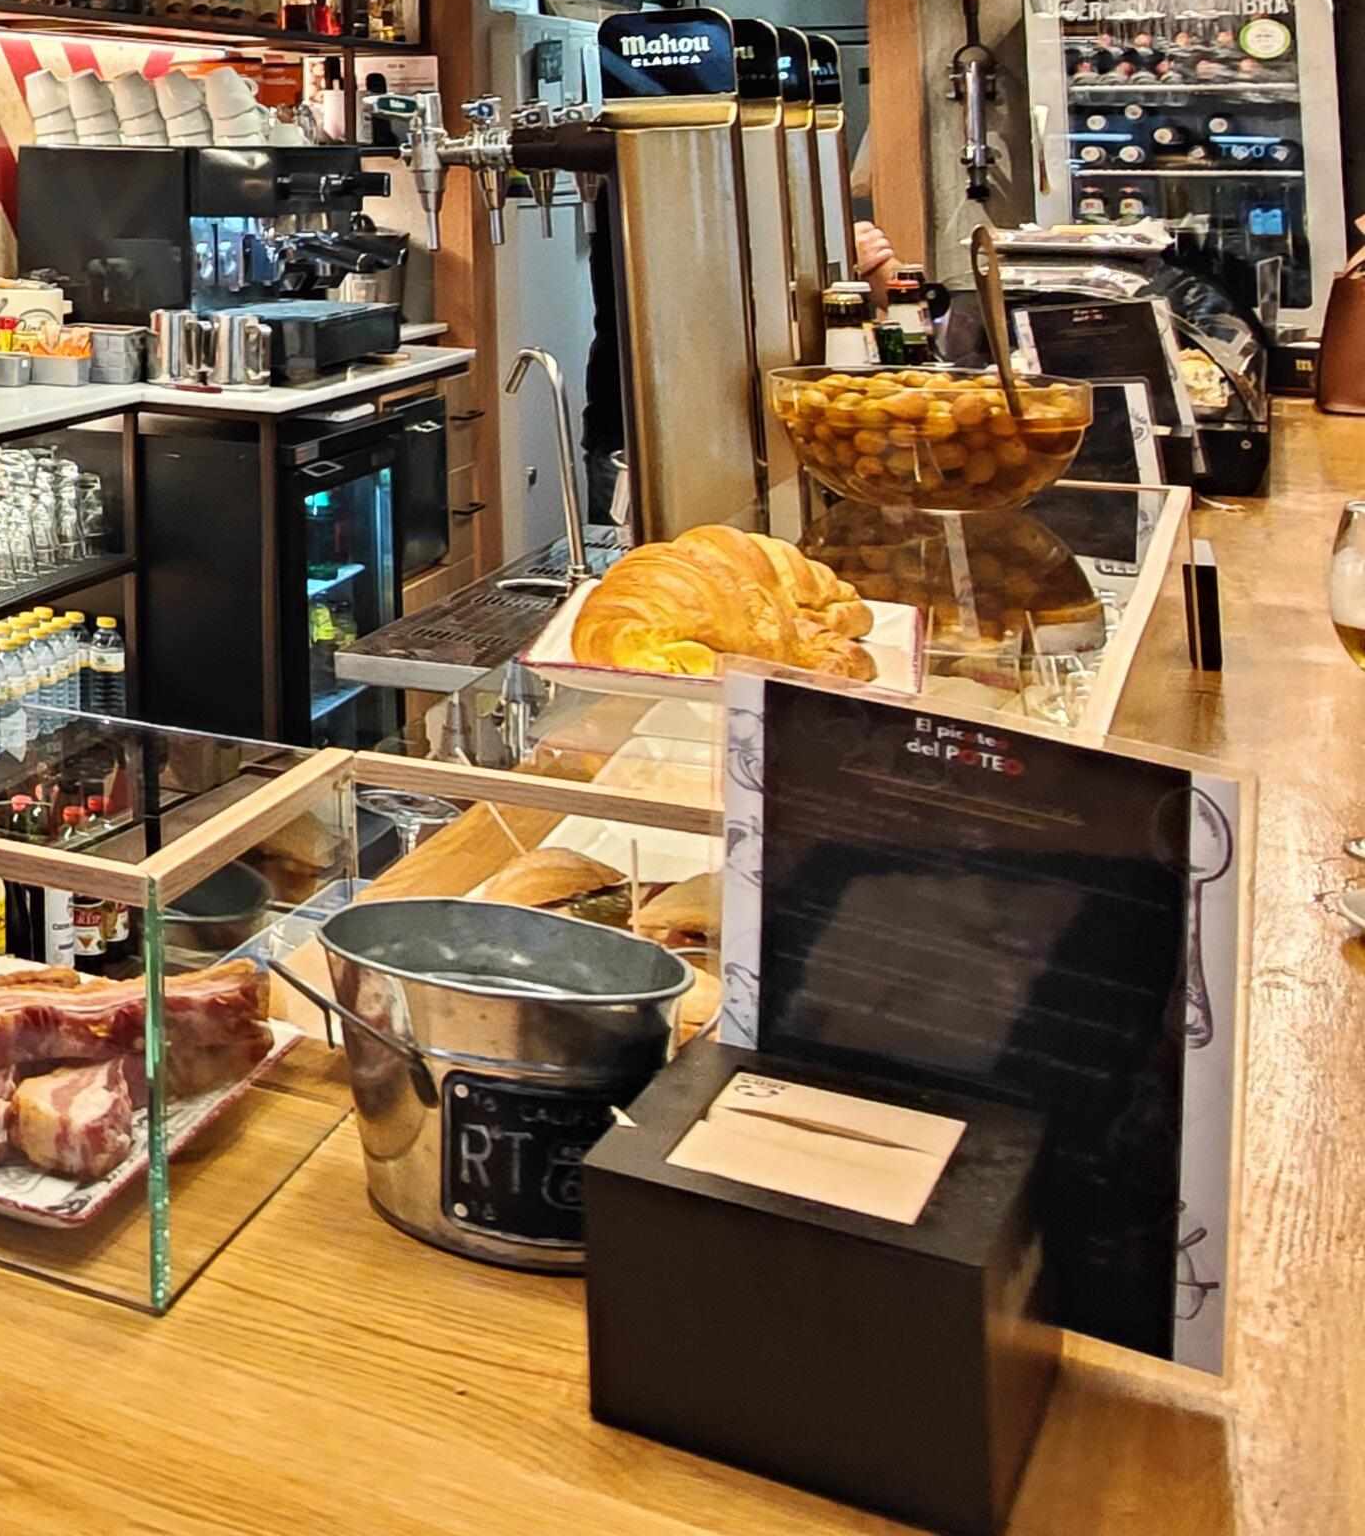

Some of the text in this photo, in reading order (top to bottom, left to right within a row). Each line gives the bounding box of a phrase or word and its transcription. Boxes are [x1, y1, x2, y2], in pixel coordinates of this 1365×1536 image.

[619, 33, 710, 56] Mahou
[915, 717, 932, 733] El
[906, 738, 939, 757] del
